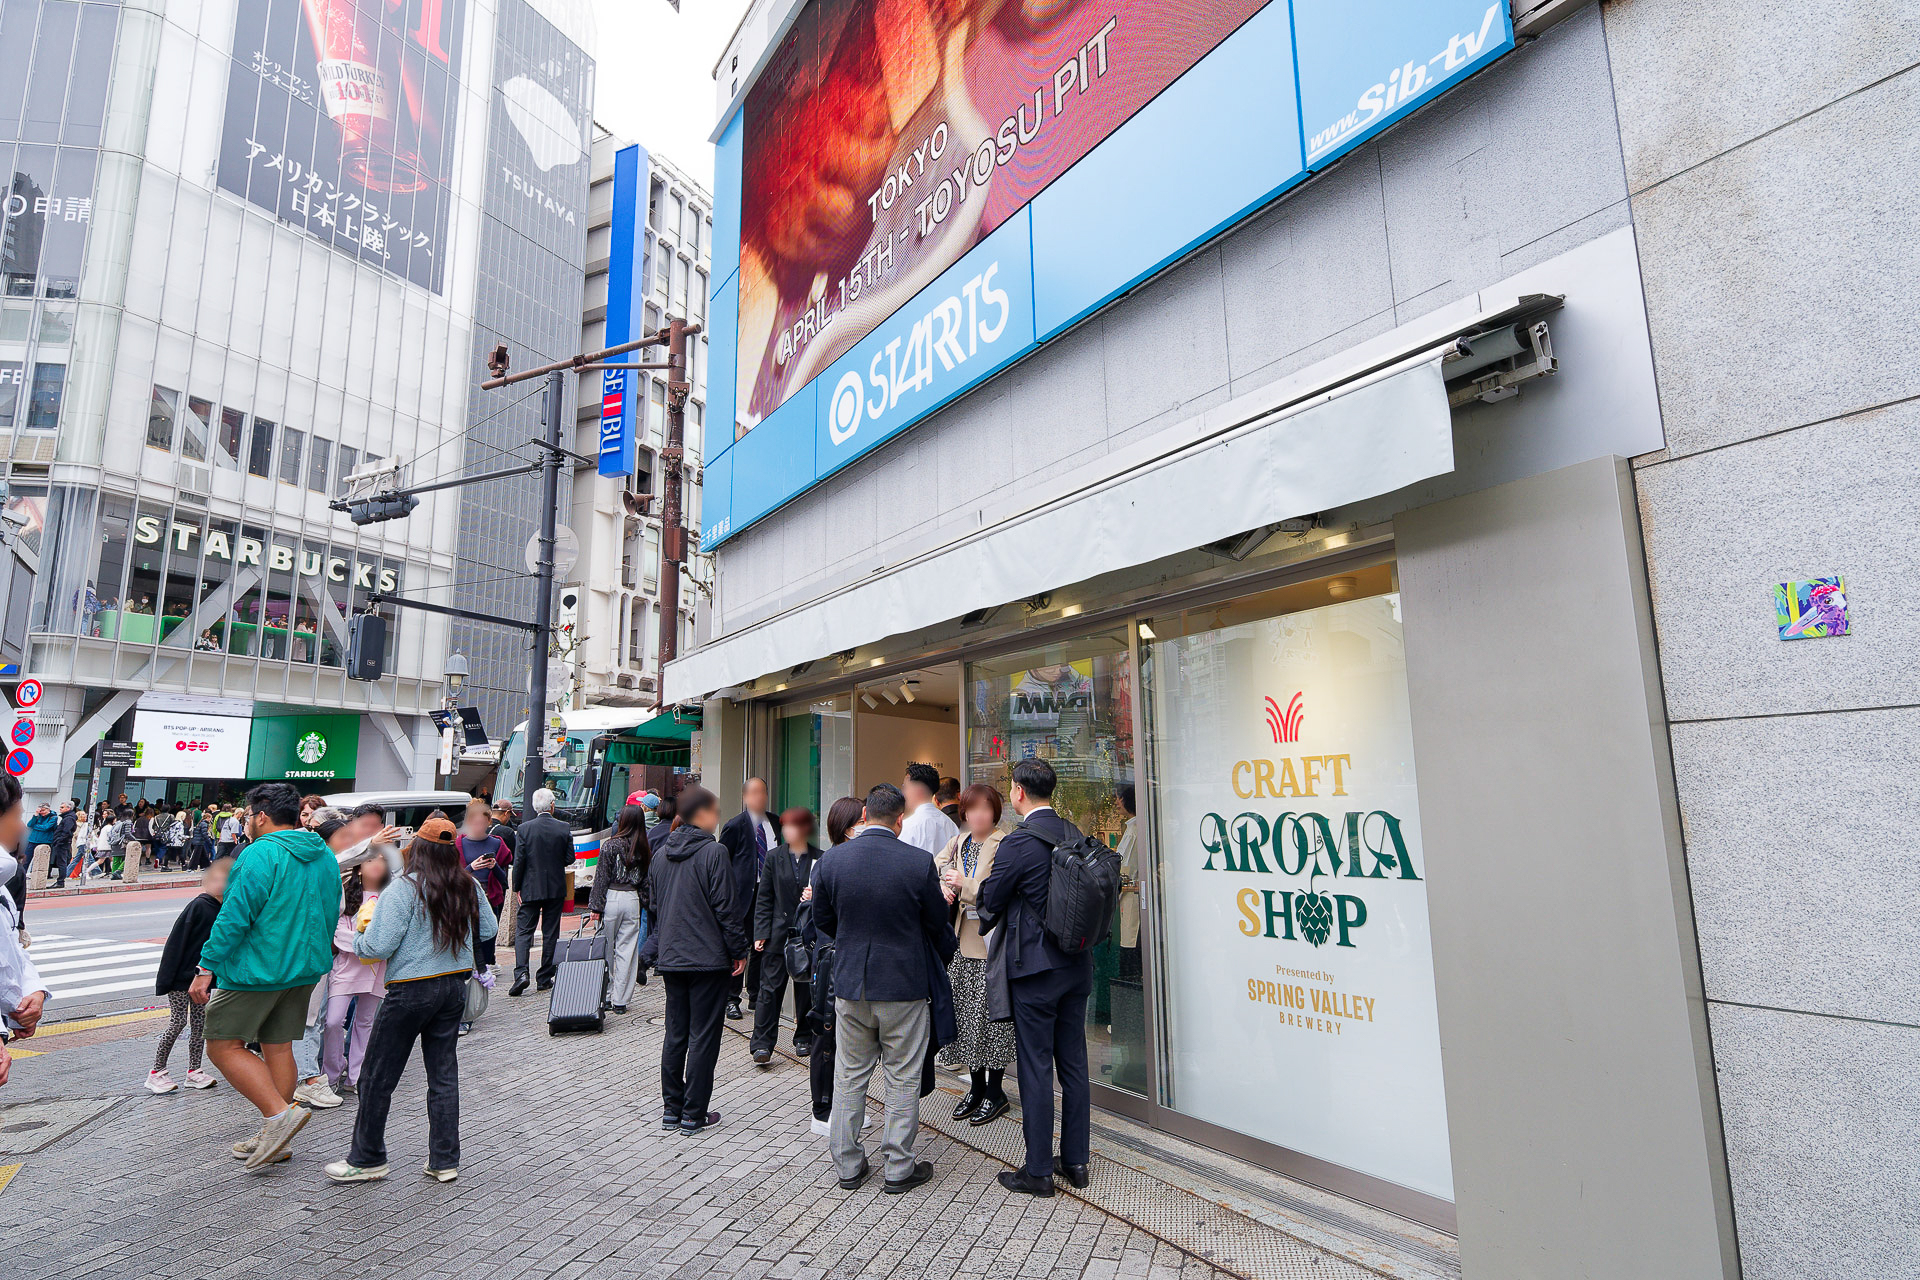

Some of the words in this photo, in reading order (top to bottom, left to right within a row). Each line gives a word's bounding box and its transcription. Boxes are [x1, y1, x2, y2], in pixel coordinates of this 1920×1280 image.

[319, 63, 343, 80] WILD
[341, 63, 385, 89] TURKEY
[335, 81, 373, 104] 101
[244, 137, 432, 257] アメリカンクラシック、
[502, 166, 576, 227] TSUTAYA
[779, 296, 834, 366] APRIL
[838, 230, 894, 312] 15TH
[914, 86, 1044, 239] TOYOSU
[1052, 14, 1118, 118] PIT
[867, 121, 949, 223] TOKYO
[291, 187, 391, 260] 日本上陸。
[134, 516, 397, 592] STARBUCKS
[285, 770, 335, 778] STARBUCKS
[1231, 753, 1351, 799] CRAFT
[1199, 810, 1424, 880] AROMA
[1247, 978, 1305, 1010] SPRING
[1309, 988, 1376, 1023] VALLEY
[1275, 964, 1322, 981] Presented
[1322, 971, 1335, 985] by
[1279, 1011, 1342, 1035] BREWERY
